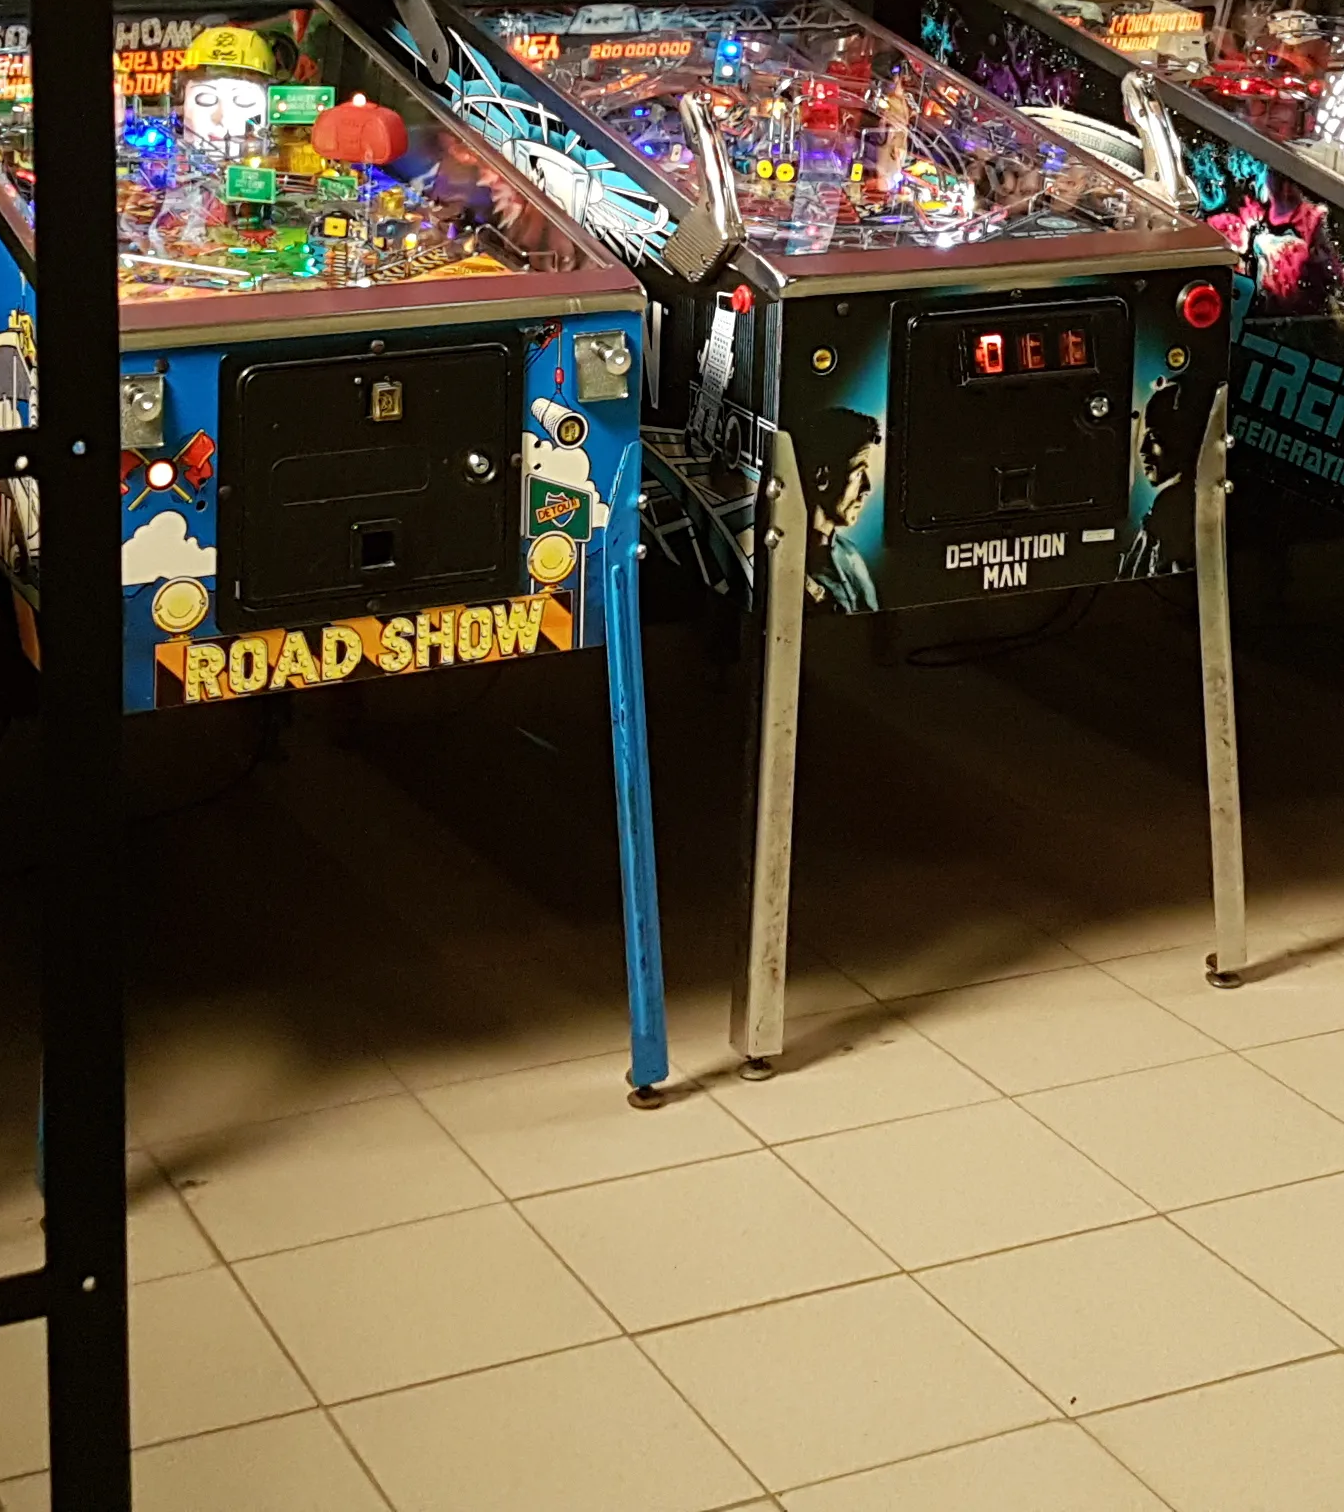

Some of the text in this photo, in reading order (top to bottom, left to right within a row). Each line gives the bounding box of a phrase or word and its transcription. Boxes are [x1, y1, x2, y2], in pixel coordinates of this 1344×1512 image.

[537, 500, 579, 522] DETOUR
[945, 532, 1065, 570] DEMOLITION
[983, 562, 1027, 589] MAN
[185, 598, 546, 703] ROAD SHOW
